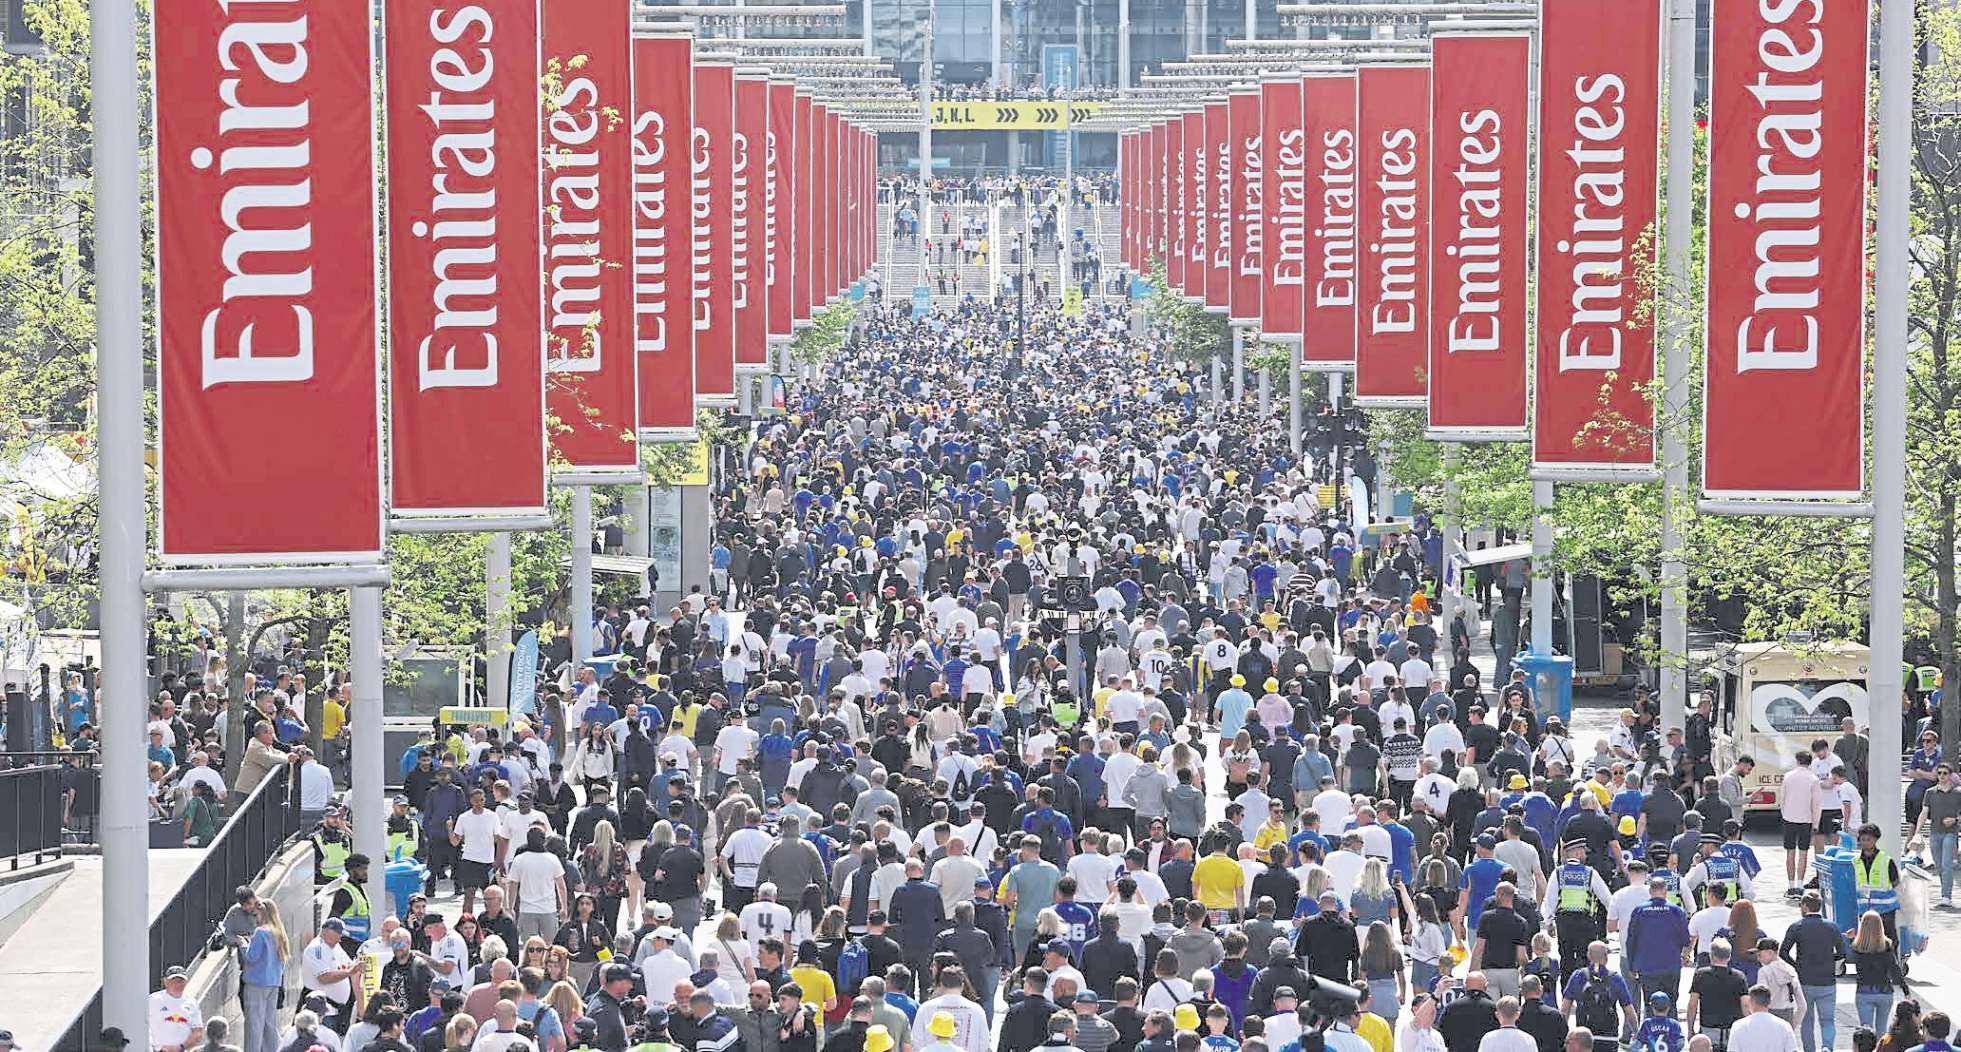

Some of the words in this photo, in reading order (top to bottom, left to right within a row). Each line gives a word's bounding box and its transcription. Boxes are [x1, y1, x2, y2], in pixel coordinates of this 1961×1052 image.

[191, 0, 314, 391] Emira
[412, 6, 498, 392] Emirates
[543, 77, 601, 373] Emirates
[1273, 129, 1305, 287] Emirates
[1315, 128, 1354, 308] Emirates
[1370, 128, 1417, 335] Emirates
[1446, 108, 1501, 354] Emirates
[1557, 72, 1625, 374] Emirates
[1735, 0, 1825, 374] Emirates
[1151, 659, 1163, 674] 10
[1217, 644, 1227, 658] 8
[1429, 781, 1440, 799] 4
[1759, 775, 1772, 784] ICE
[758, 912, 774, 935] 4
[1654, 1034, 1669, 1052] 6
